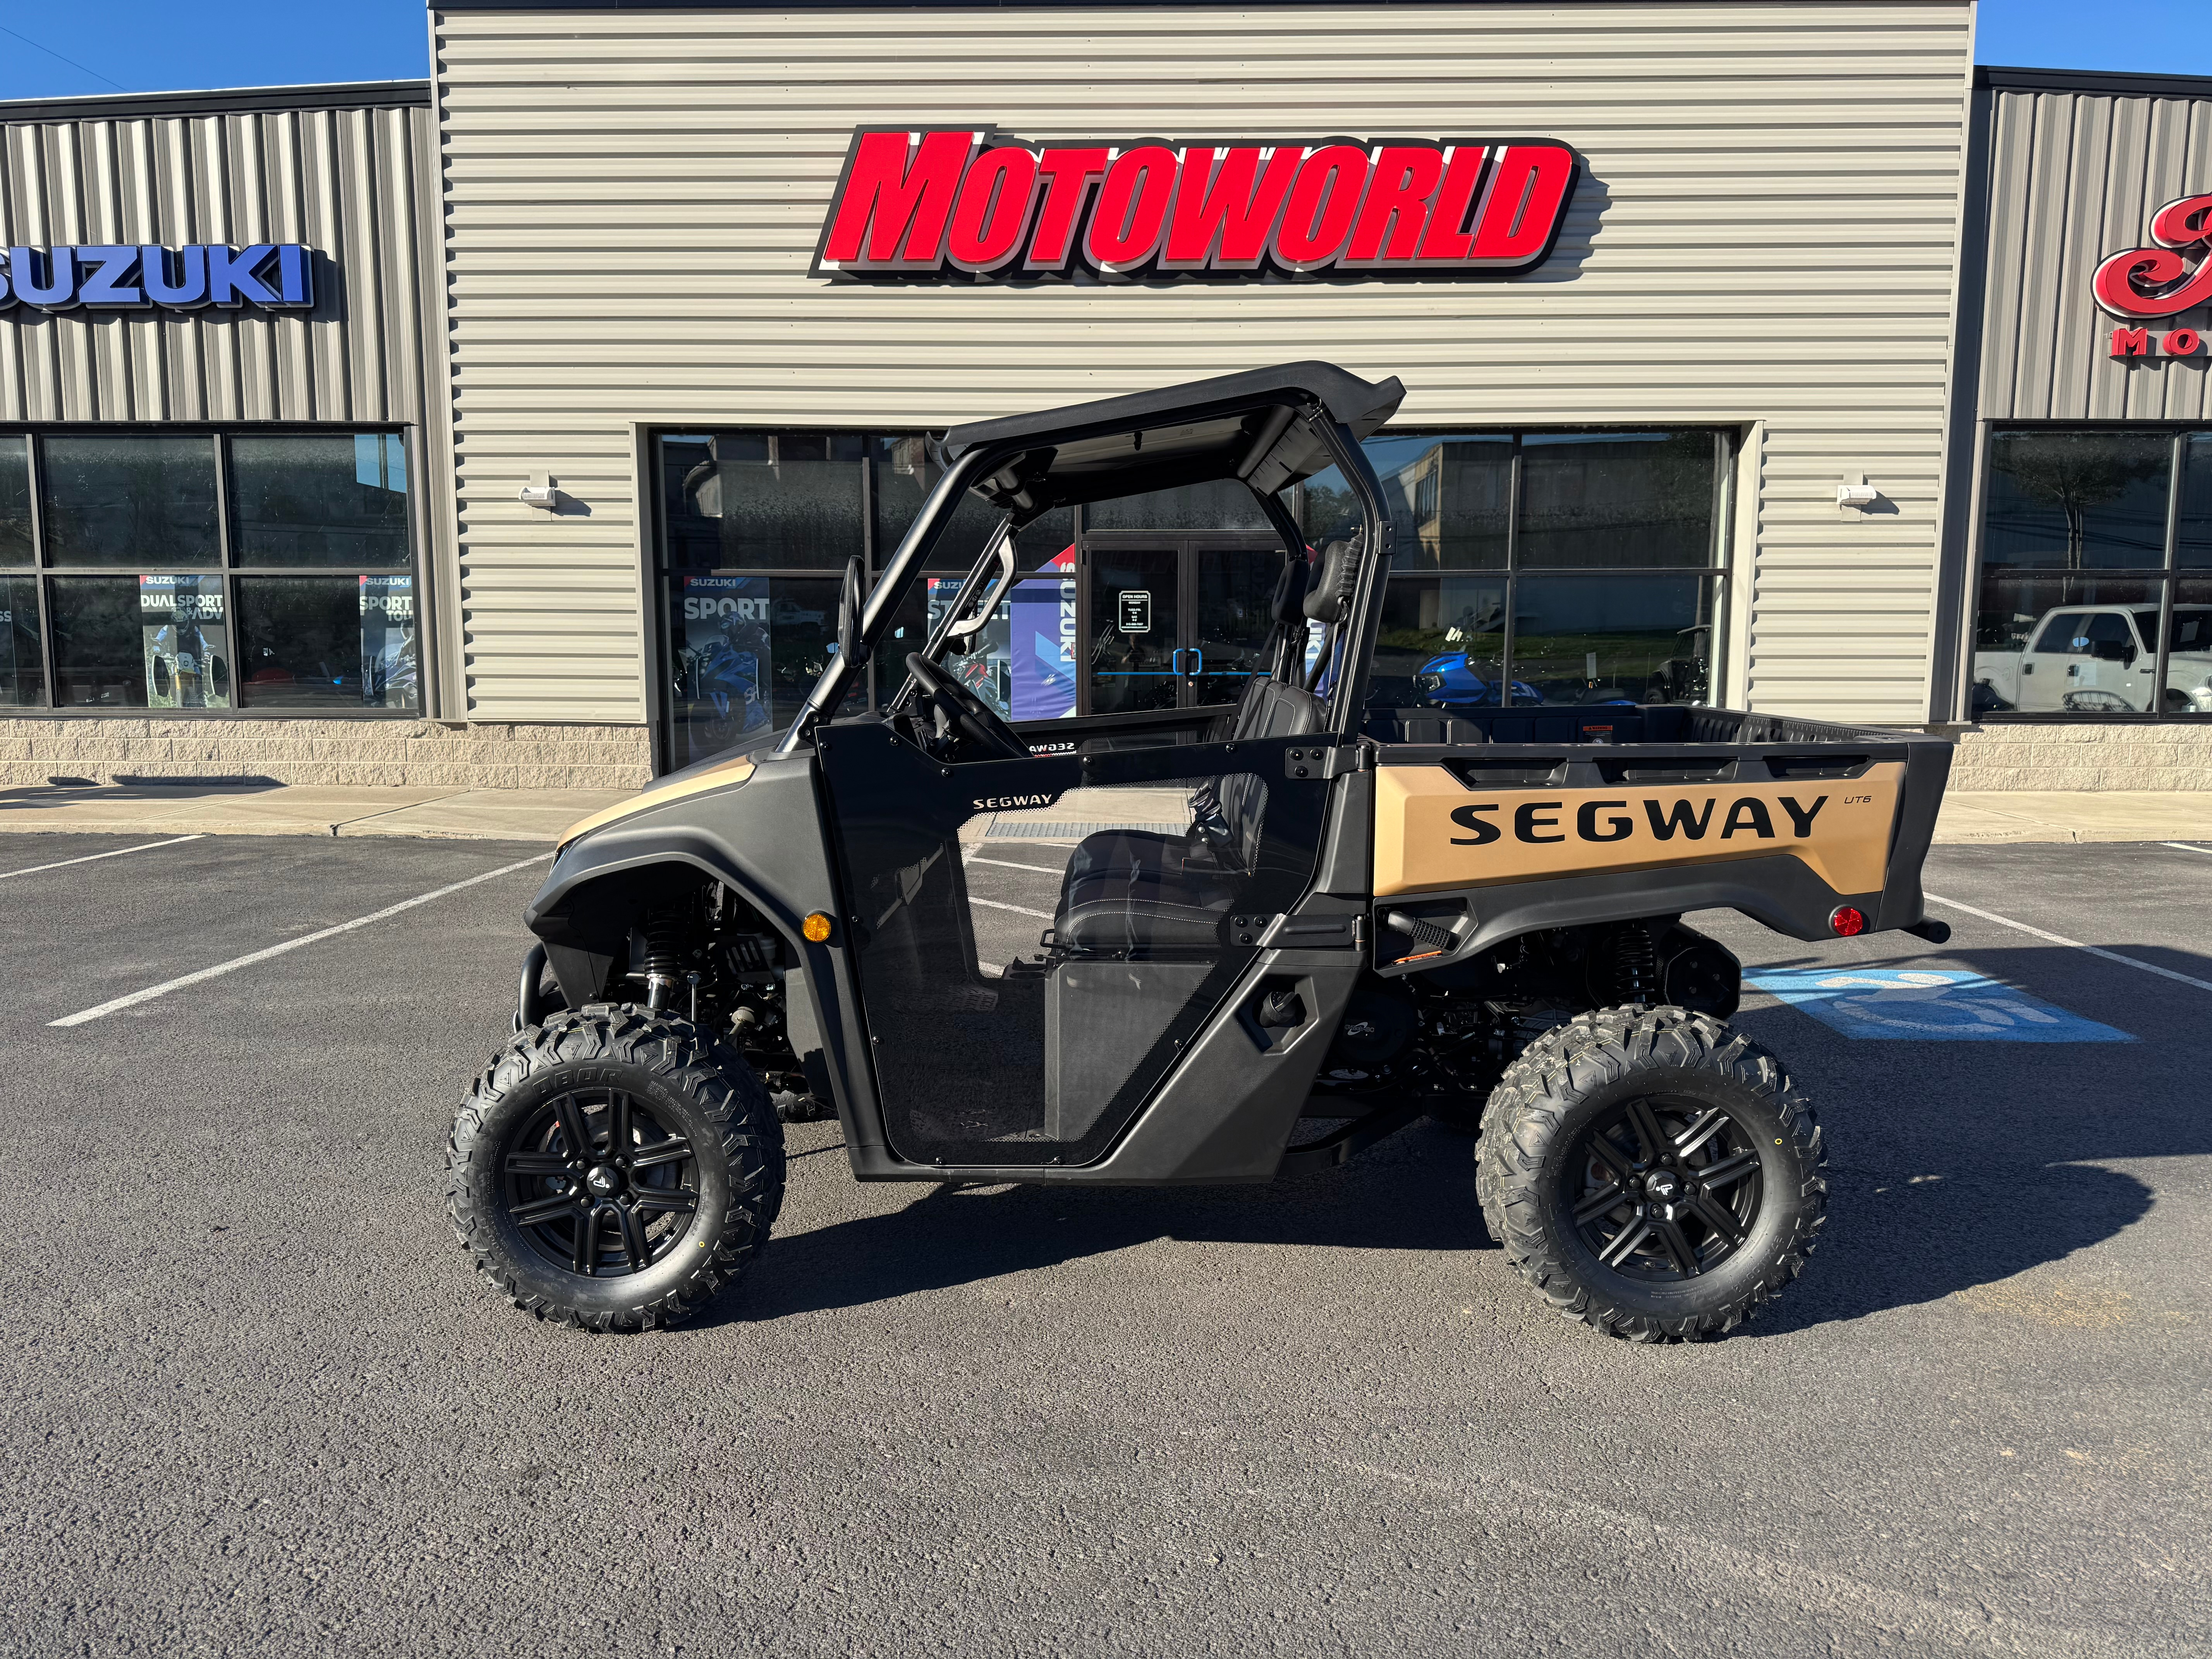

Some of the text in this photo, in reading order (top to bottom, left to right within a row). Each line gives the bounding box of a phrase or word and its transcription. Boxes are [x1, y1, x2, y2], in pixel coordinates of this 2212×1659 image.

[824, 131, 1573, 265] MOTOWORLD
[0, 245, 310, 308] UZUKI
[146, 576, 189, 584] SUZUKI
[366, 577, 409, 586] SUZUKI
[690, 579, 736, 587] SUZUKI
[360, 596, 412, 610] SPORT
[684, 597, 770, 620] SPORT
[192, 607, 224, 620] ADV
[973, 794, 1052, 809] SEGWAY
[1450, 795, 1872, 846] SEGWAY UT6
